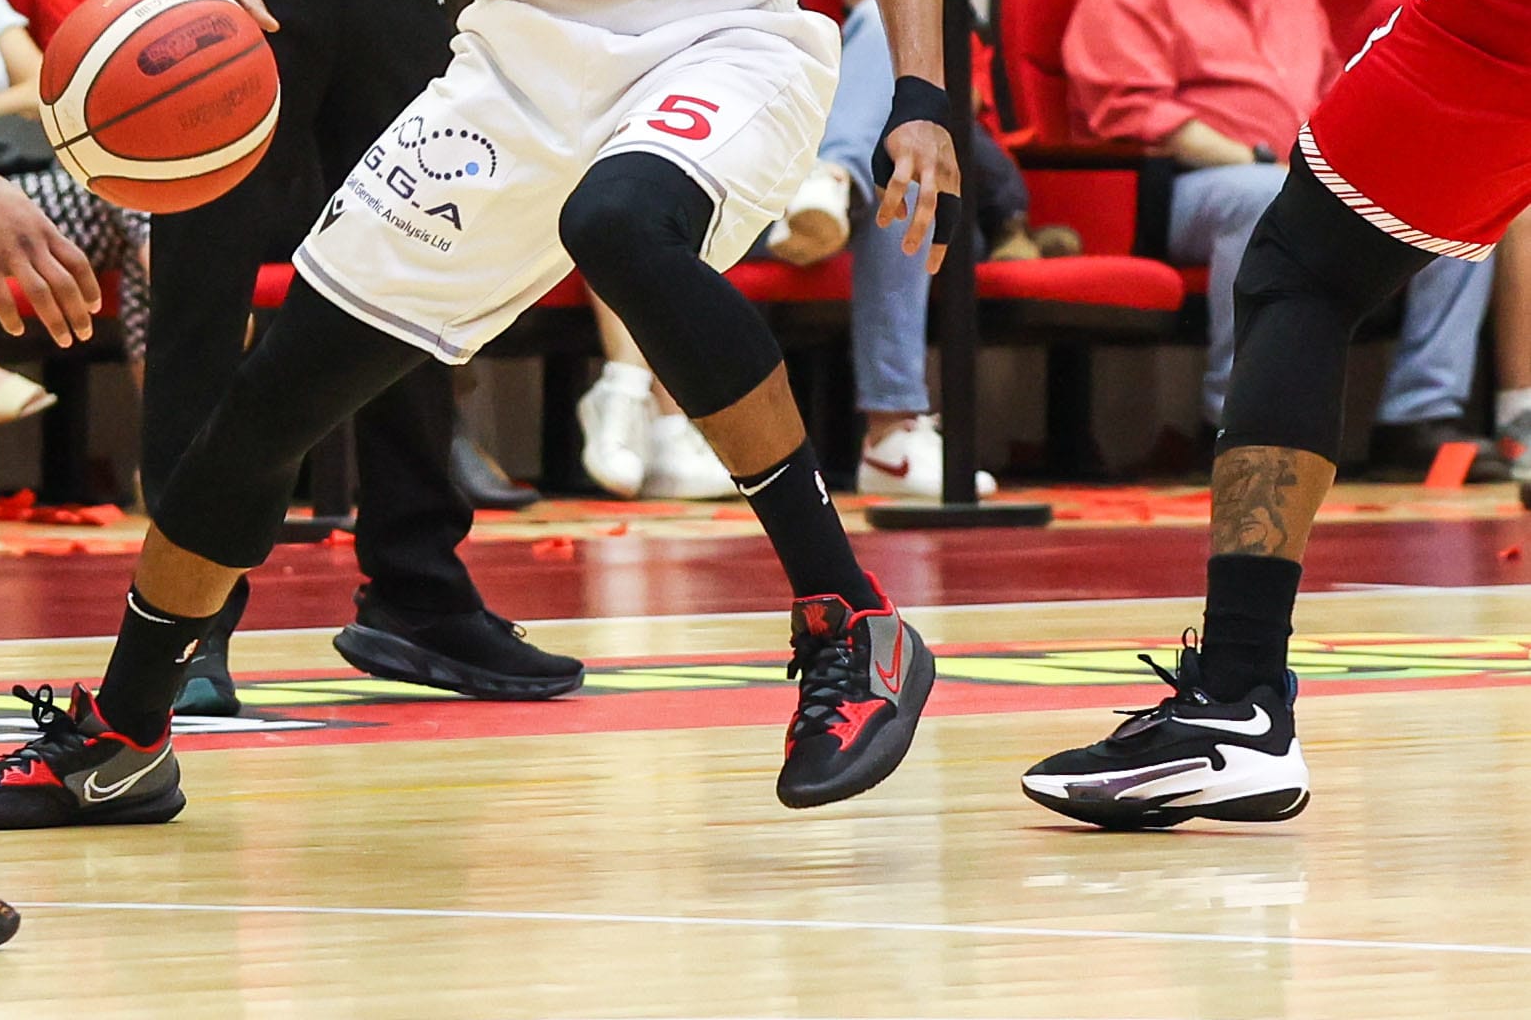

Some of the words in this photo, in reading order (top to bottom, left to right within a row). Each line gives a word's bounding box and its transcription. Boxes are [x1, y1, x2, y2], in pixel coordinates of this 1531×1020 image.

[647, 94, 719, 141] 5
[381, 209, 430, 242] Analysis
[430, 235, 452, 252] Ltd
